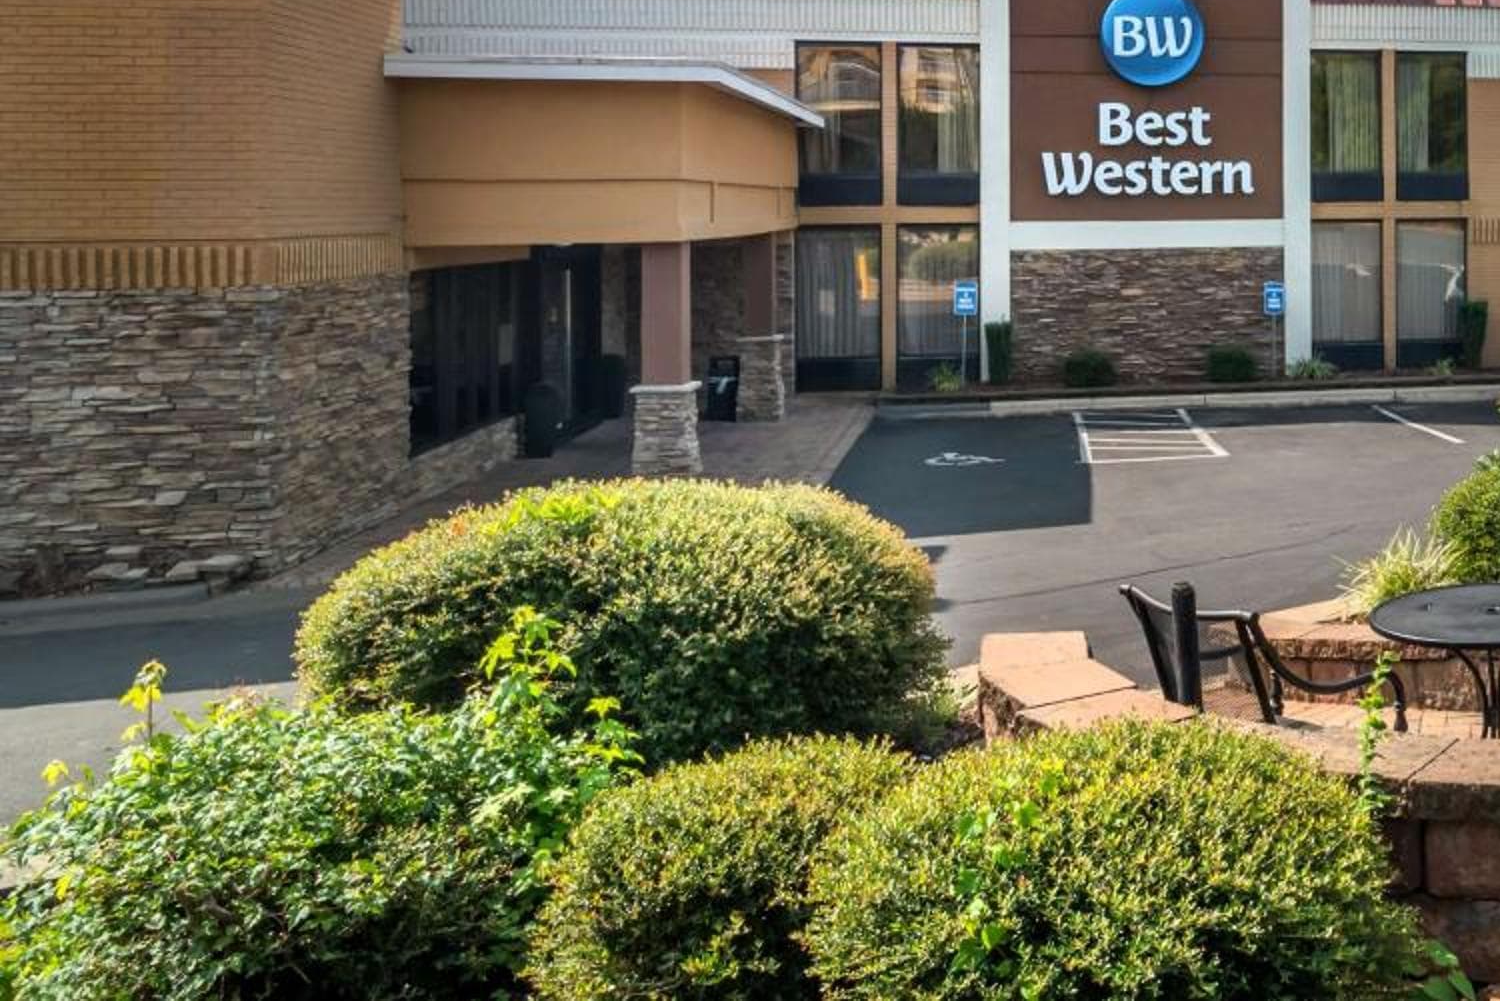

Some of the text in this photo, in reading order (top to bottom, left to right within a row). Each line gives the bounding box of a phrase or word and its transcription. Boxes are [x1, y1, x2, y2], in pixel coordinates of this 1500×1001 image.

[1112, 15, 1193, 58] BW
[1098, 102, 1212, 147] Best
[1041, 151, 1255, 196] Western
